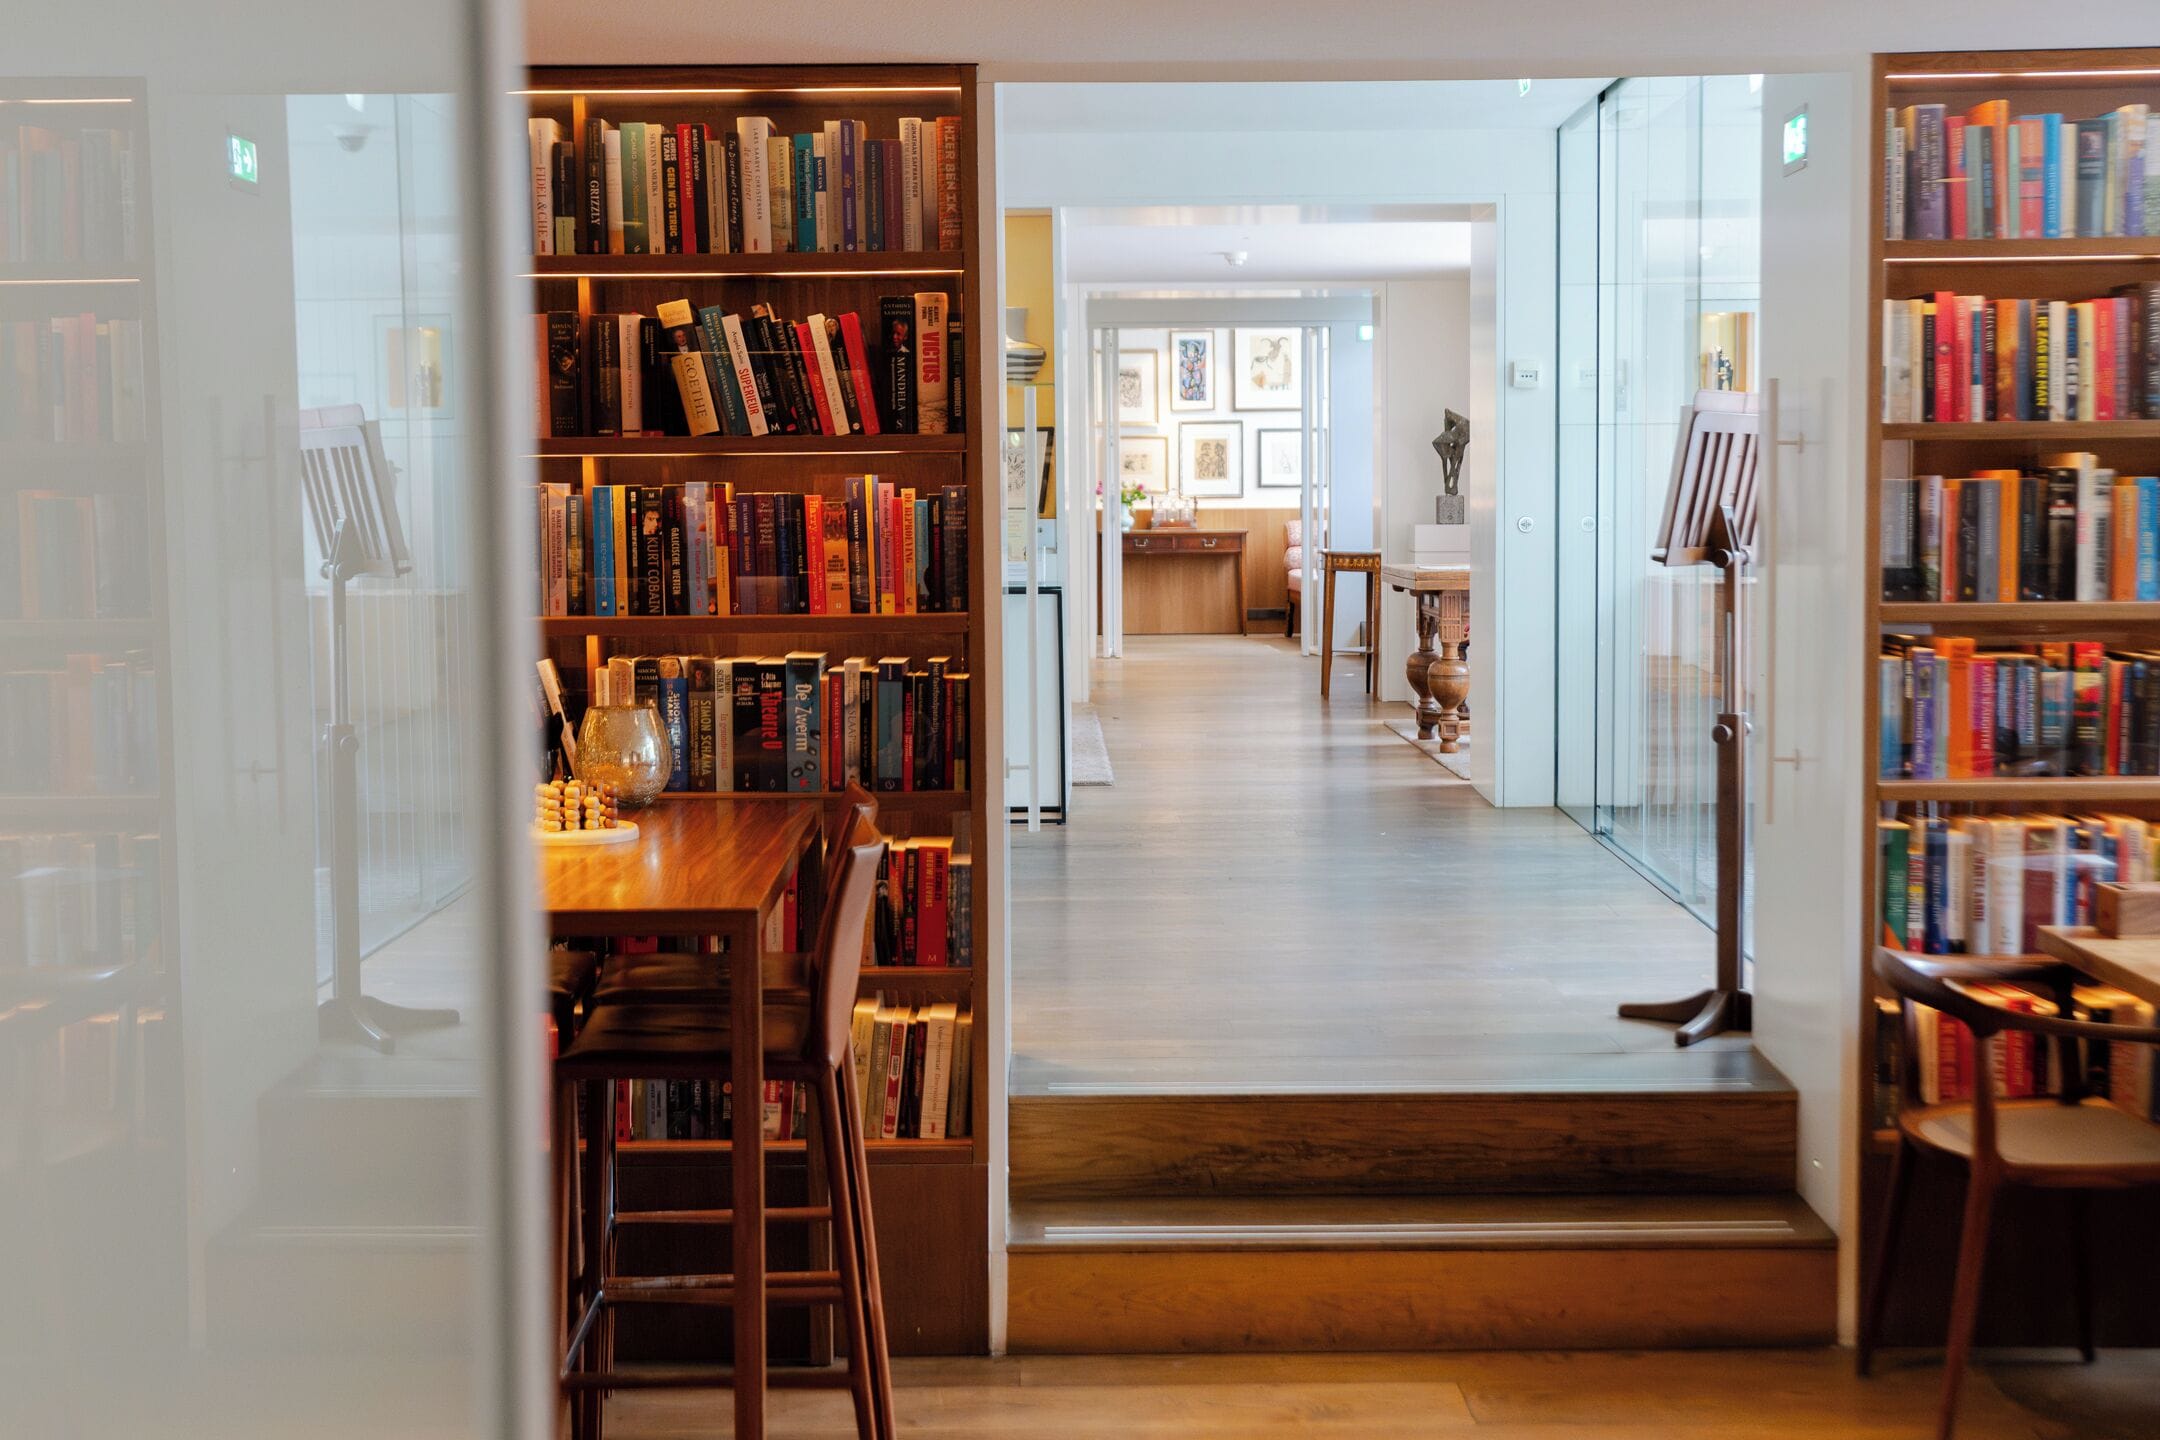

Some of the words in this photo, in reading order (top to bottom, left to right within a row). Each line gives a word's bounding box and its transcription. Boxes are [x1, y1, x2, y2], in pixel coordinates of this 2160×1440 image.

[744, 147, 751, 157] de
[944, 126, 955, 159] HIER
[667, 167, 675, 188] GEEN
[945, 164, 956, 190] BEN
[590, 180, 600, 225] GRIZZLY
[668, 190, 676, 208] WEG
[946, 194, 957, 213] IK
[669, 211, 677, 237] TERUG
[2037, 316, 2048, 328] IK
[731, 331, 741, 350] Angela
[2036, 330, 2048, 353] ZAG
[922, 332, 940, 384] VICTUS
[2036, 355, 2048, 377] EEN
[683, 357, 708, 417] GOETHE
[738, 368, 759, 416] SUPERIEUR
[896, 356, 906, 411] MANDELA
[2036, 380, 2048, 406] MAN
[904, 493, 912, 505] DE
[728, 504, 737, 532] SAPPHIRE
[671, 528, 680, 566] GALICISCHE
[905, 507, 914, 563] BEPROEVING
[647, 537, 659, 566] KURT
[648, 569, 660, 613] COBAIN
[672, 569, 681, 595] WETTEN
[795, 683, 813, 701] De
[700, 700, 711, 731] SIMON
[761, 691, 782, 738] Theorie
[847, 710, 856, 739] SLAAP
[1980, 697, 1994, 750] SLAUGHTER
[795, 706, 812, 752] Zwerm
[701, 735, 712, 776] SCHAMA
[762, 741, 782, 749] U
